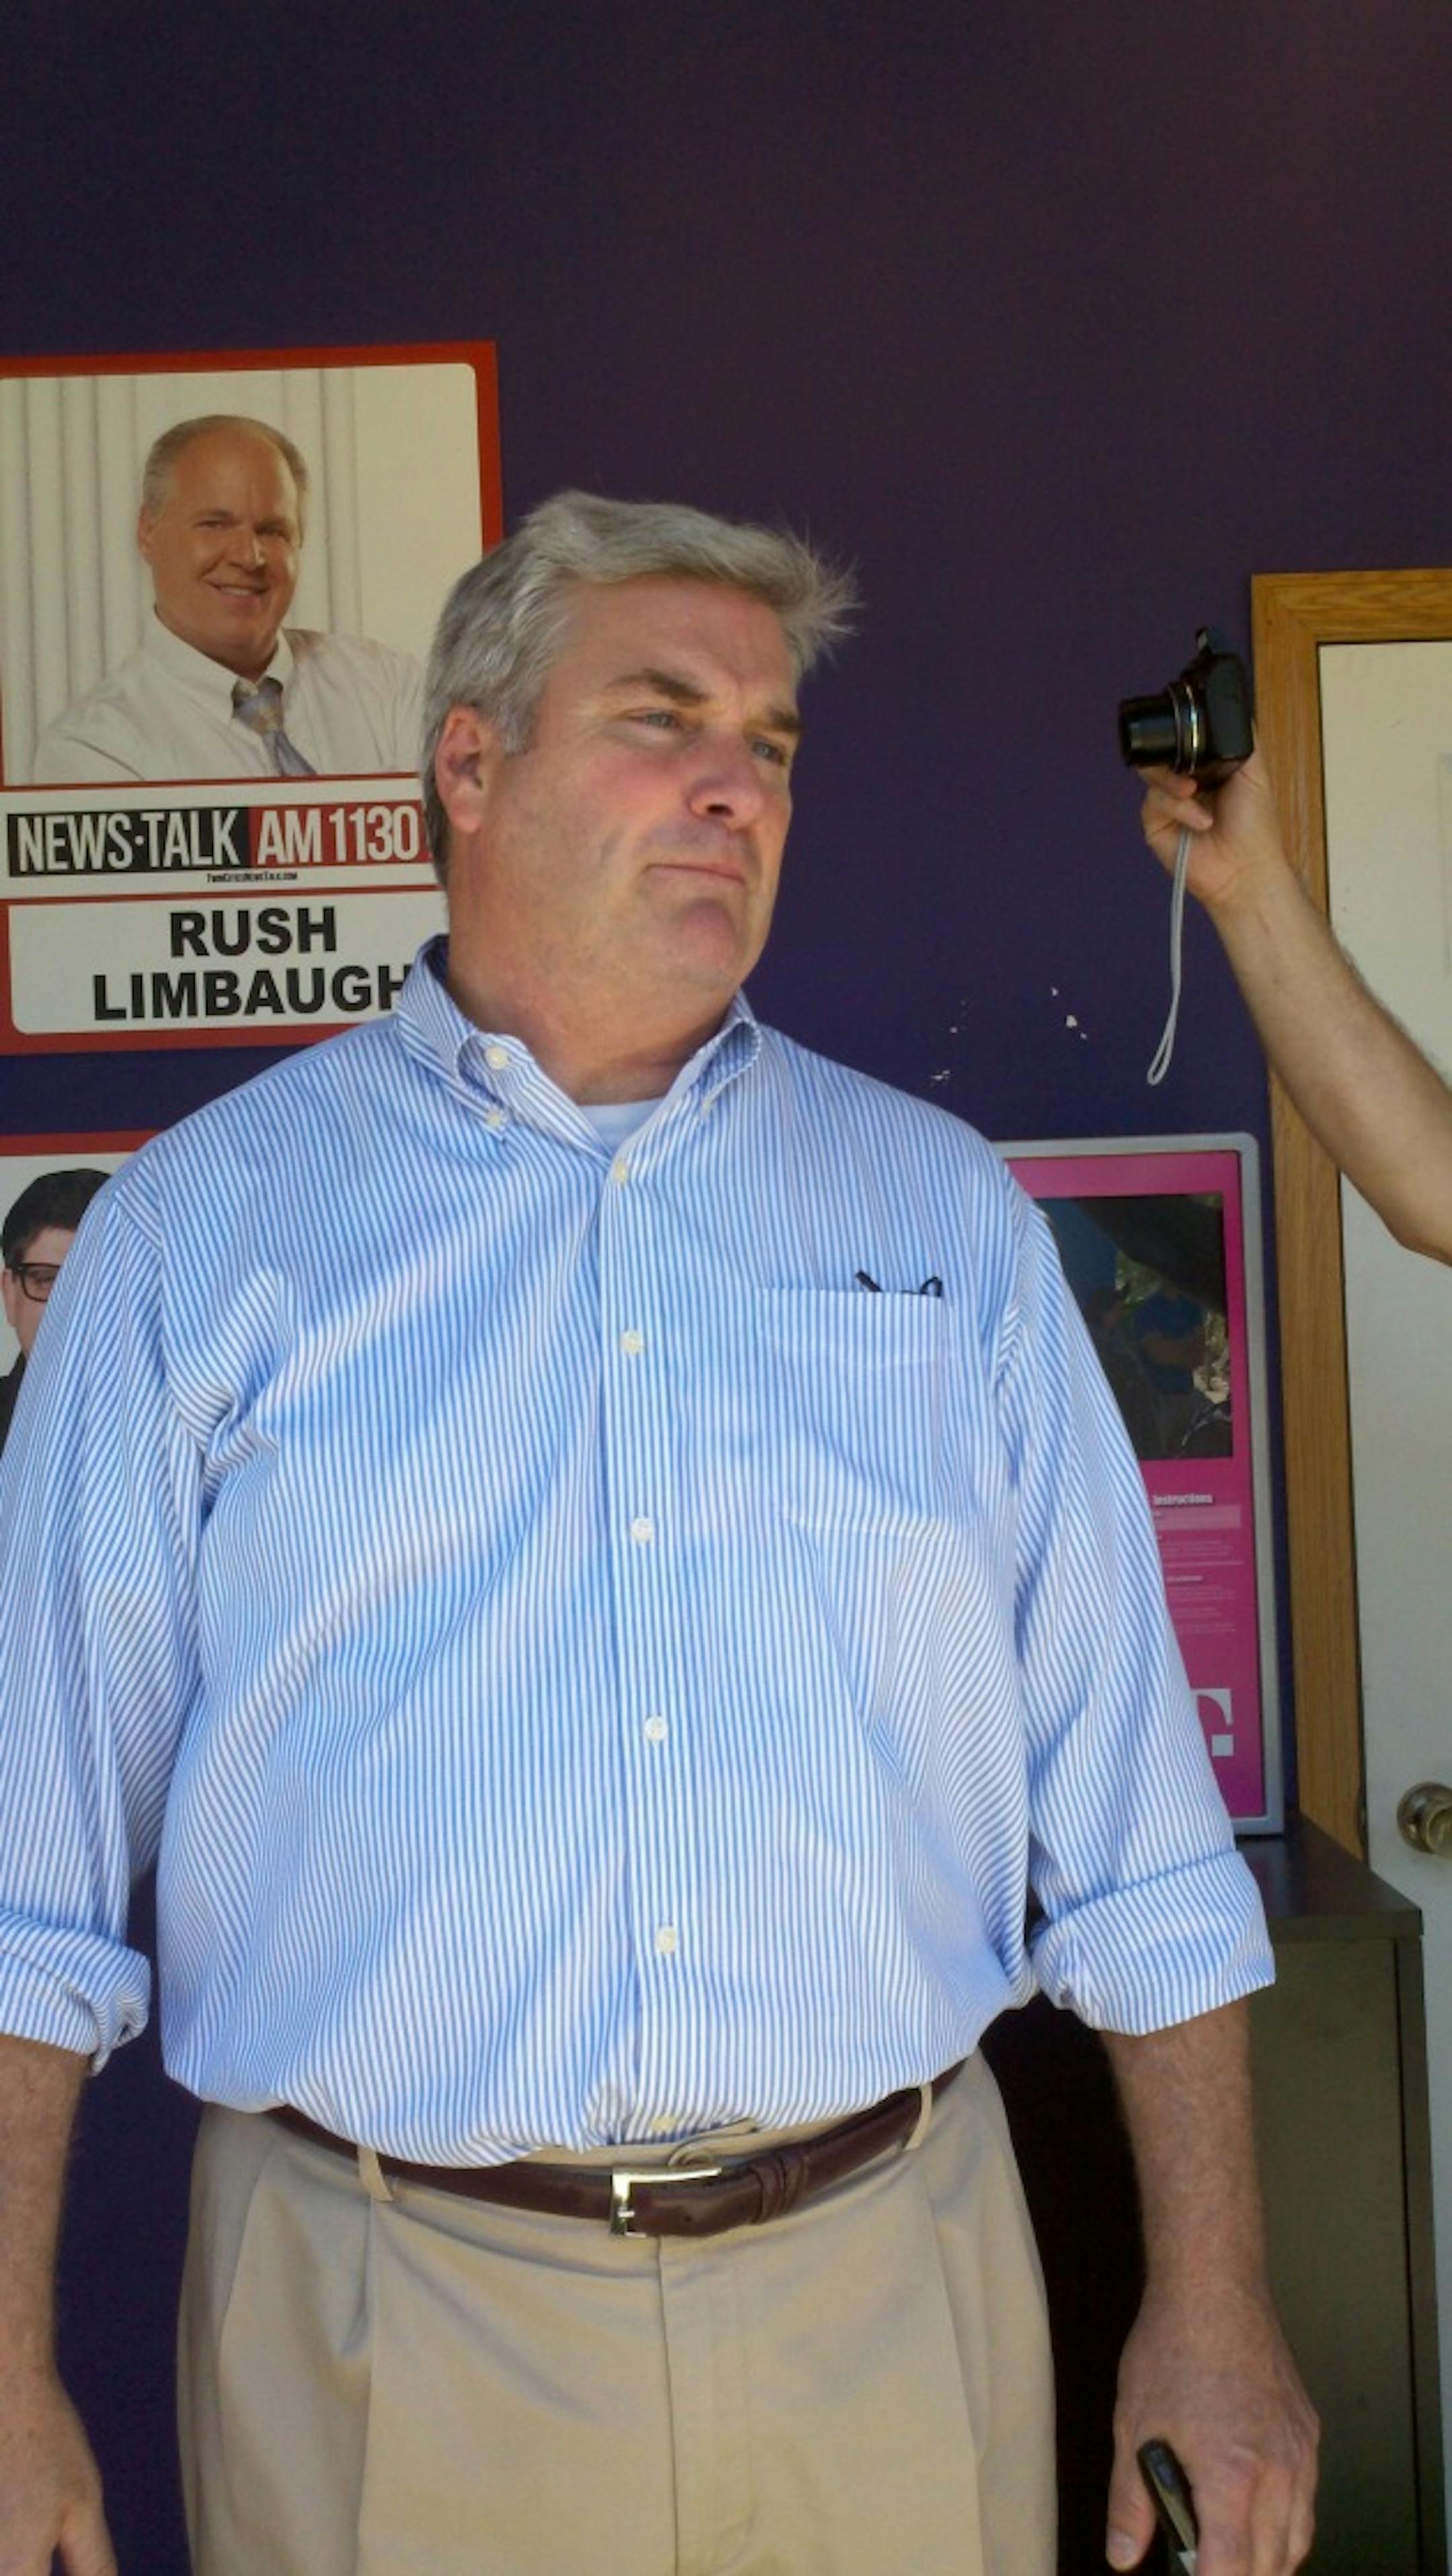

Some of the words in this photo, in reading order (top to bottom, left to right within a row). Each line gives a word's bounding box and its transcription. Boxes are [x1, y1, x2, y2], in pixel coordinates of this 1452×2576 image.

[257, 806, 322, 864] AM
[329, 805, 419, 861] 1130
[169, 907, 336, 958] RUSH
[93, 966, 411, 1020] LIMBAUGH
